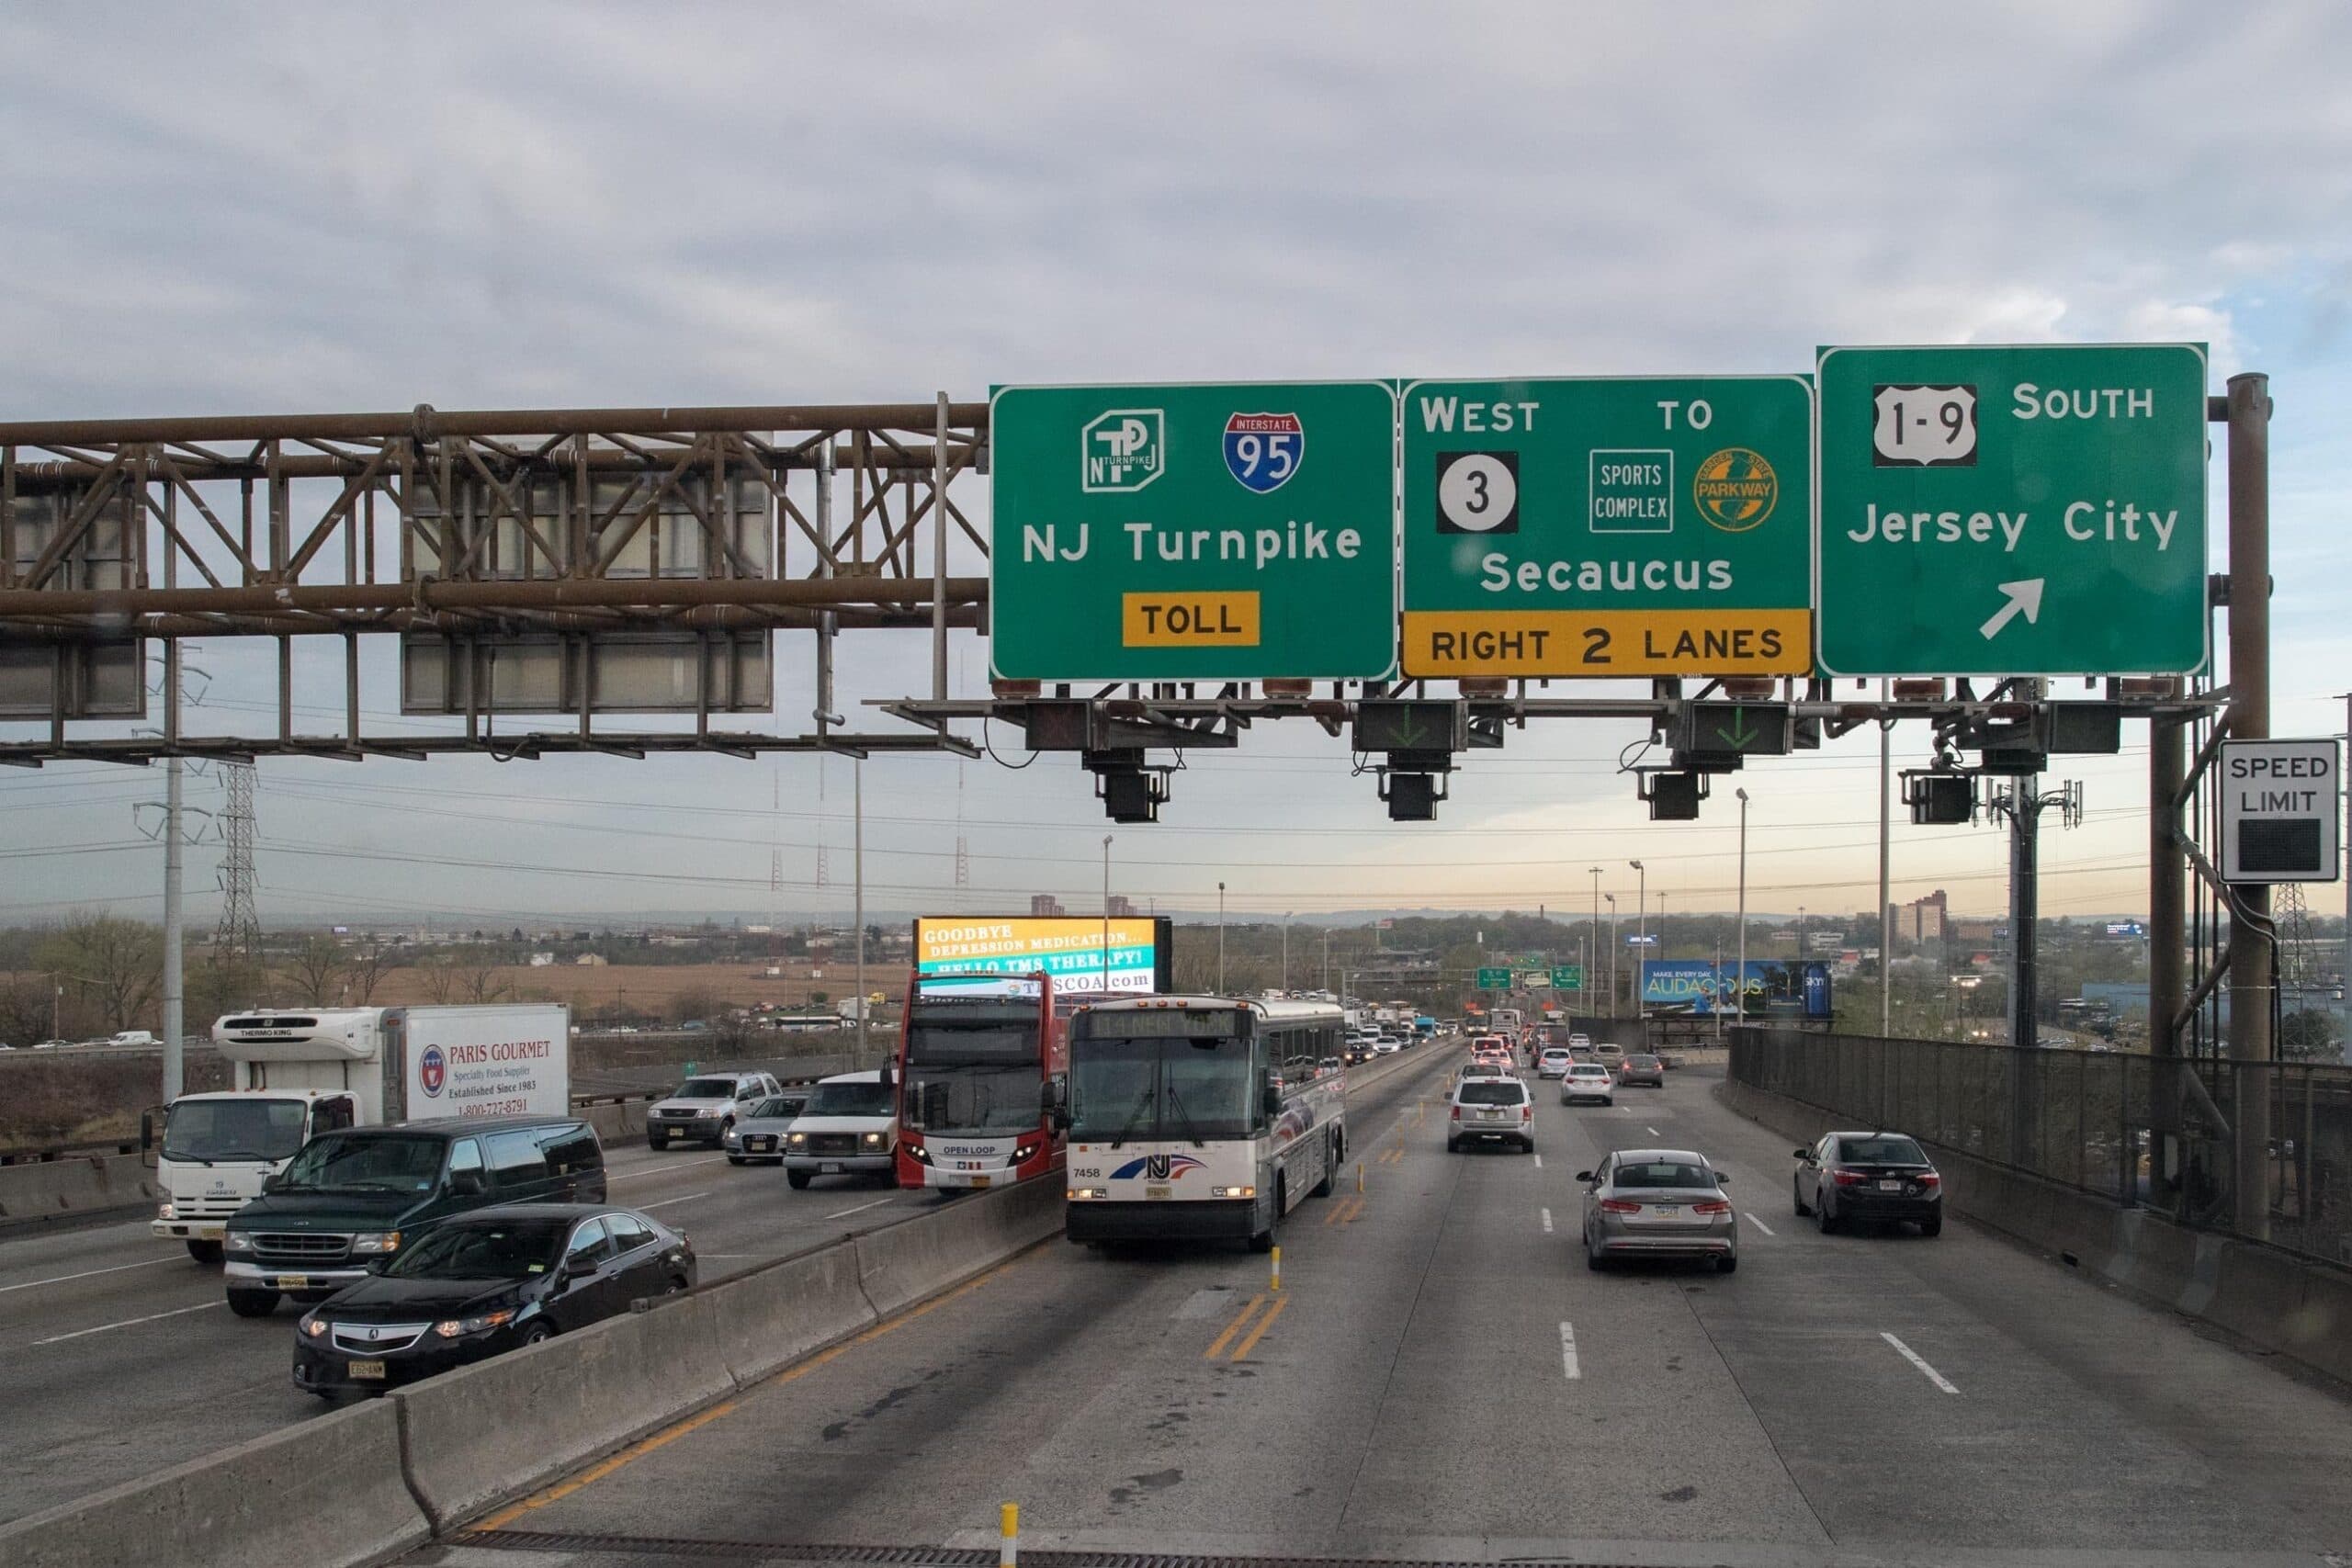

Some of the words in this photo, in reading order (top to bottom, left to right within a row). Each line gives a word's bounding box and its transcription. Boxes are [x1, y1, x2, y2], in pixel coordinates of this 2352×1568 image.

[2011, 382, 2154, 419] SOUTH
[1236, 419, 1292, 431] INTERSTATE
[1420, 397, 1540, 433] WEST
[1657, 400, 1713, 430] TO
[1893, 400, 1964, 446] 1-9
[1104, 456, 1151, 465] TURNPIKE
[1237, 434, 1293, 479] 95
[1601, 465, 1662, 486] SPORTS
[1465, 470, 1489, 513] 3
[1699, 482, 1772, 497] PARKWAY
[1595, 497, 1668, 518] COMPLEX
[1847, 503, 2028, 551] Jersey
[2064, 501, 2178, 551] City
[1023, 524, 1089, 562] NJ
[1124, 520, 1362, 570] Turnpike
[1480, 553, 1733, 592] Secaucus
[1141, 604, 1242, 634] TOLL
[1431, 631, 1550, 661] RIGHT
[1582, 628, 1611, 663] 2
[1645, 629, 1782, 660] LANES
[2231, 757, 2329, 779] SPEED
[2241, 791, 2317, 812] LIMIT
[924, 925, 1012, 943] GOODBYE
[930, 940, 1024, 957] DEPRESSION
[1005, 958, 1043, 971] TMS
[1023, 975, 1149, 994] TSCOA.com
[450, 1044, 487, 1064] PARIS
[492, 1041, 550, 1061] GOURMET
[454, 1069, 484, 1083] Specialty
[486, 1068, 503, 1078] Food
[504, 1066, 530, 1079] Supplier
[448, 1085, 494, 1099] Established
[497, 1083, 516, 1093] Since
[1073, 1168, 1101, 1178] 7458
[1147, 1154, 1170, 1179] NJ
